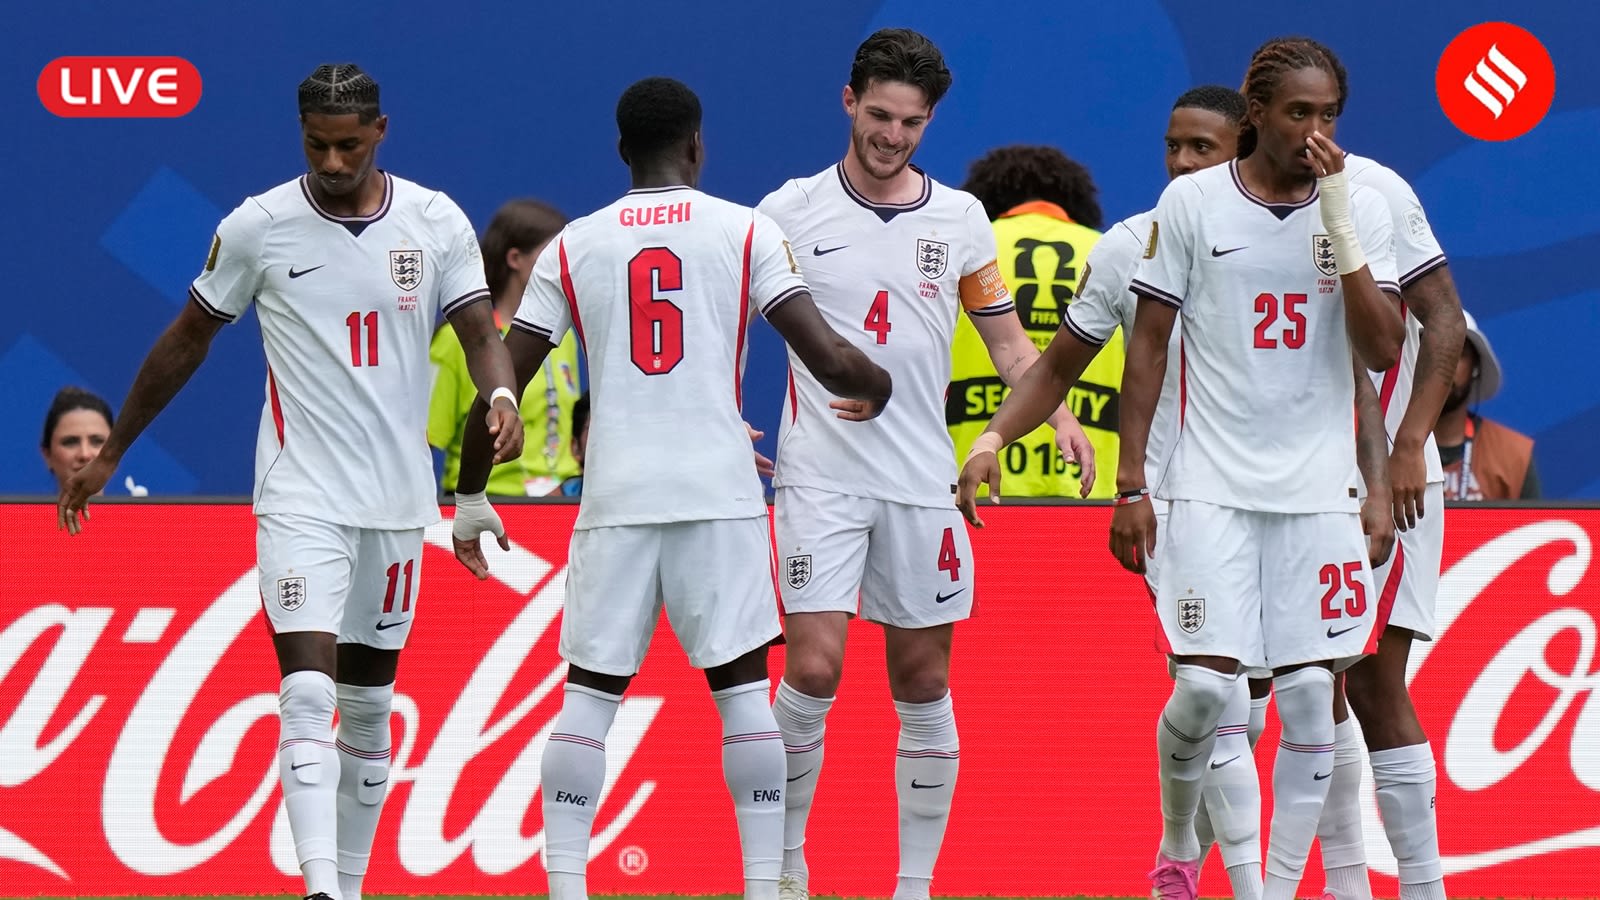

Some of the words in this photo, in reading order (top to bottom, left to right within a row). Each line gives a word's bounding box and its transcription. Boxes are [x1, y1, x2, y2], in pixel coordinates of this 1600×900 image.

[619, 202, 691, 227] GUÉHI
[627, 246, 684, 376] 6
[918, 281, 940, 292] FRANCE
[346, 311, 379, 367] 11
[863, 290, 892, 345] 4
[1030, 311, 1060, 325] FIFA
[1253, 292, 1308, 350] 25
[965, 384, 1111, 423] SEITY
[937, 527, 961, 582] 4
[382, 558, 414, 614] 11
[1318, 560, 1368, 620] 25
[555, 790, 588, 807] ENG
[753, 789, 781, 802] ENG
